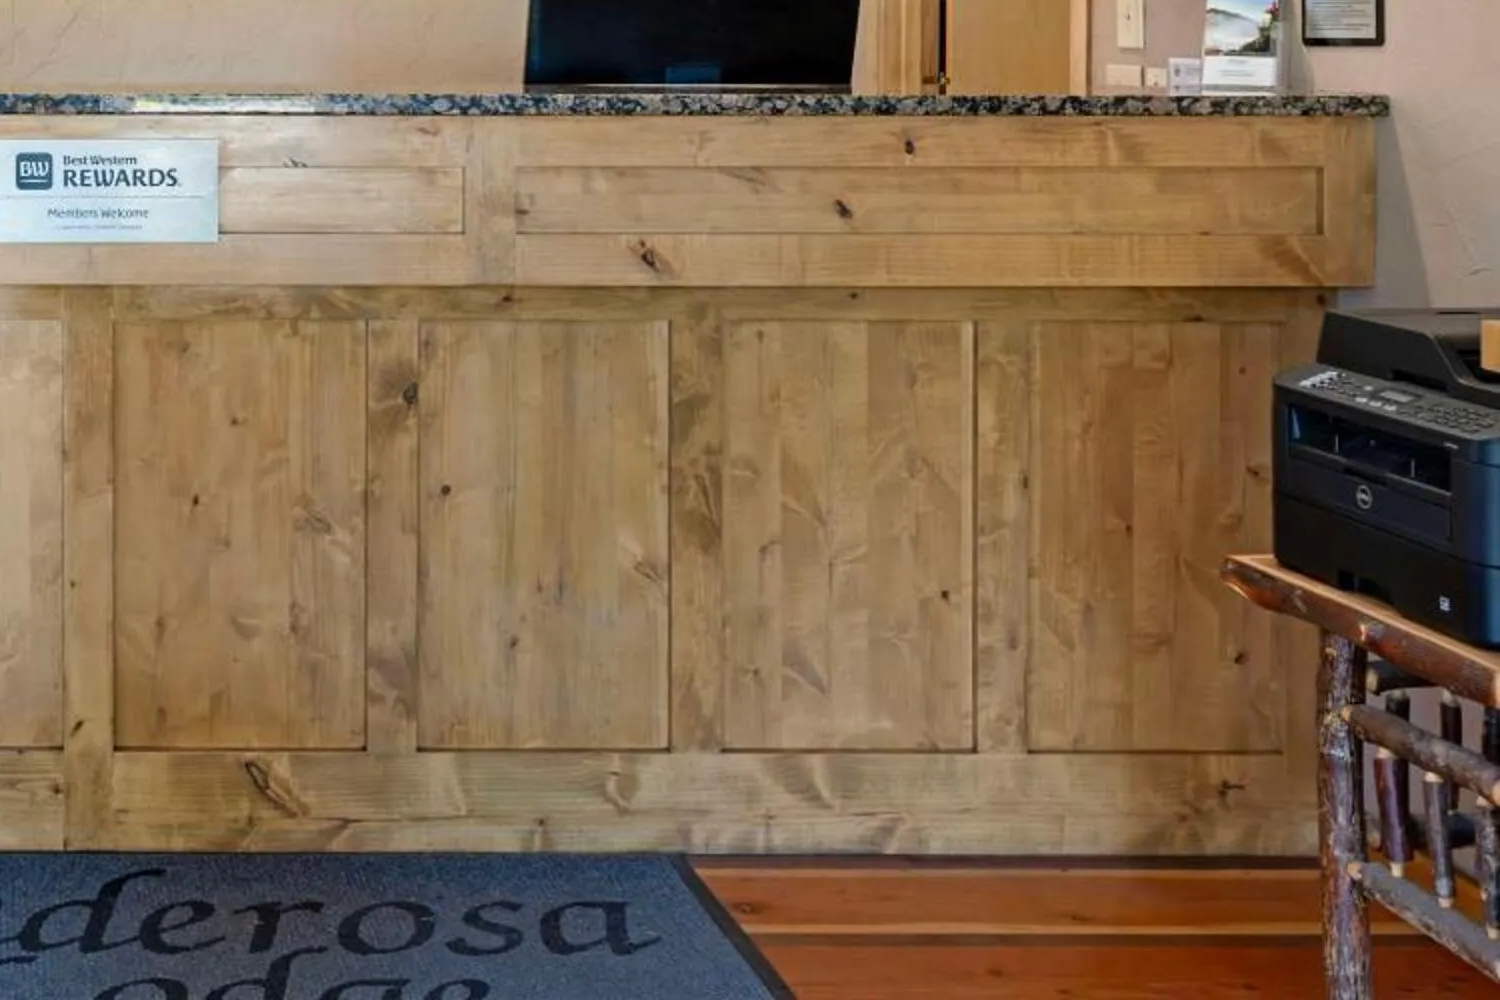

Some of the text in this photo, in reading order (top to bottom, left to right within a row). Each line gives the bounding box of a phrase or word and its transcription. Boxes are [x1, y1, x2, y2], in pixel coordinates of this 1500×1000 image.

[63, 155, 138, 166] Best Western
[19, 160, 49, 177] BW
[63, 168, 179, 188] REWARDS
[47, 207, 149, 219] Members Welcome
